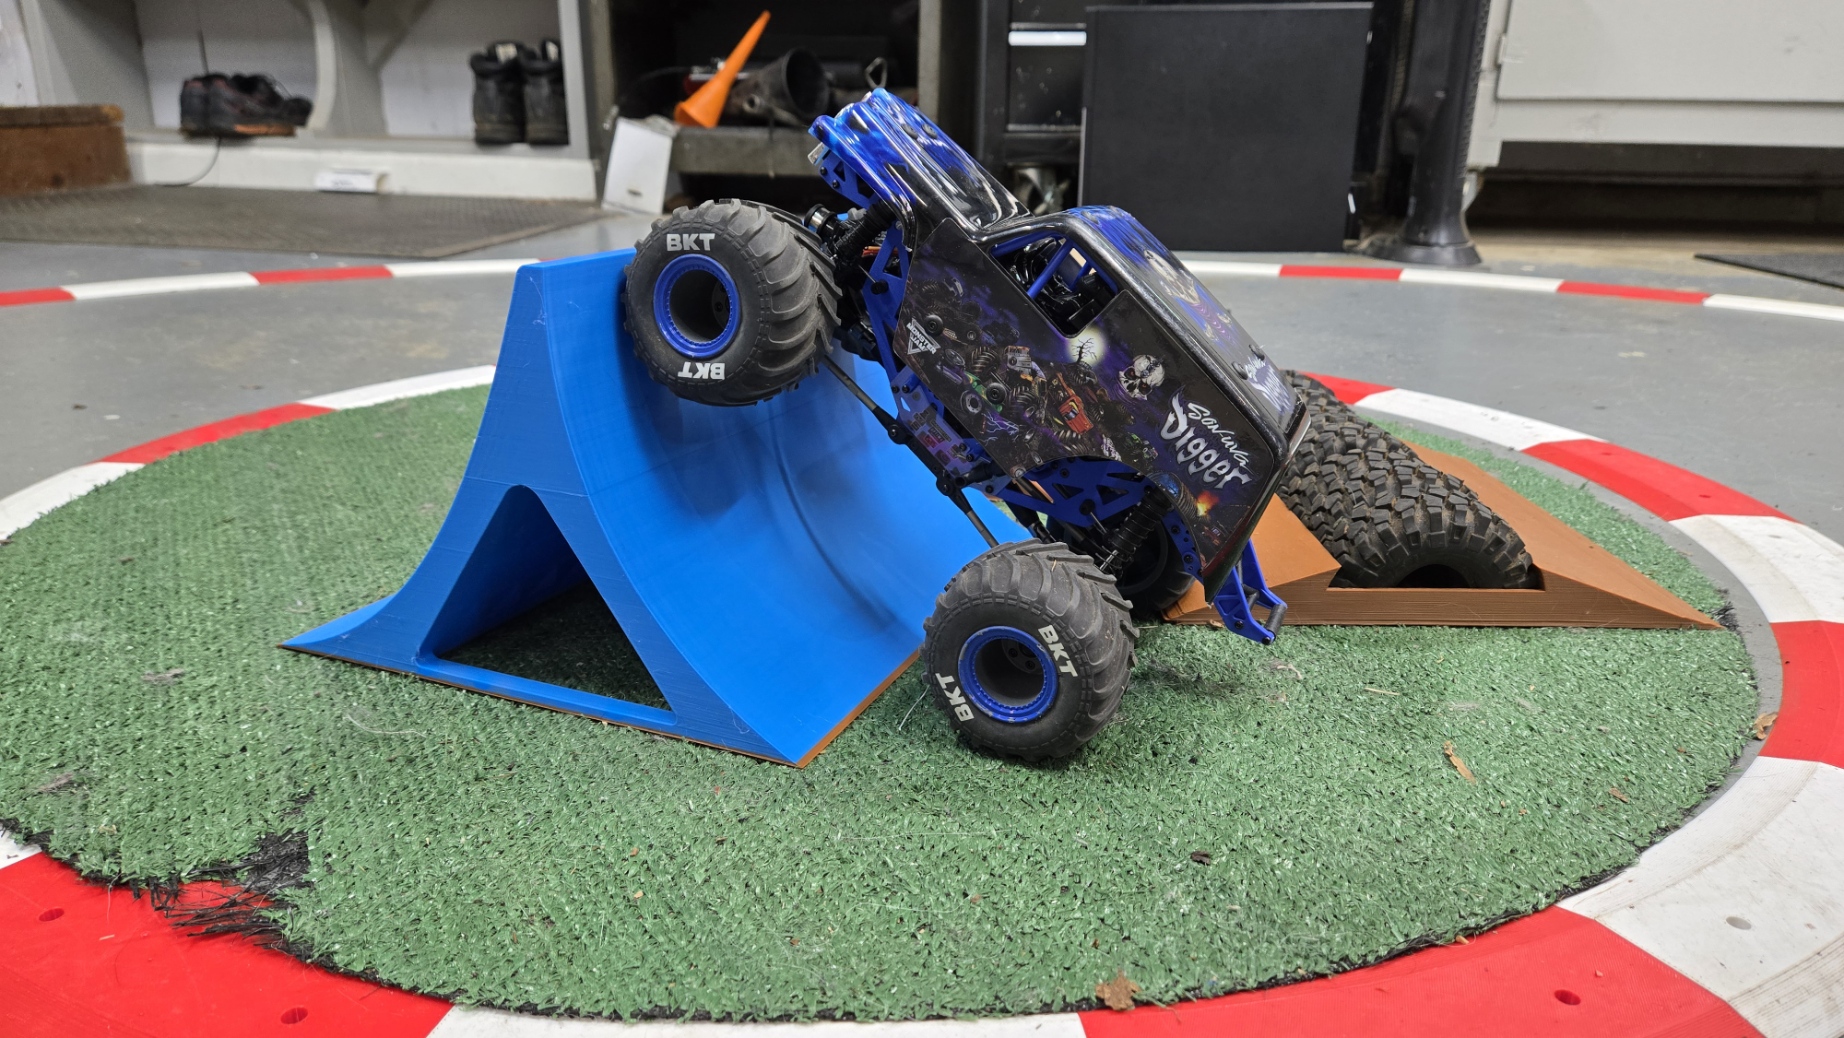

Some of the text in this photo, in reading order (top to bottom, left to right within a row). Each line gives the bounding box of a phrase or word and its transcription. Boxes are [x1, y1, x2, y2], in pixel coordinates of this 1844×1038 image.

[666, 233, 715, 251] BKT
[906, 322, 937, 354] MONSTER
[910, 334, 926, 351] JAM
[677, 361, 726, 380] BKT
[1160, 392, 1252, 489] Digger
[1038, 624, 1078, 677] BKT
[935, 672, 975, 722] BKT
